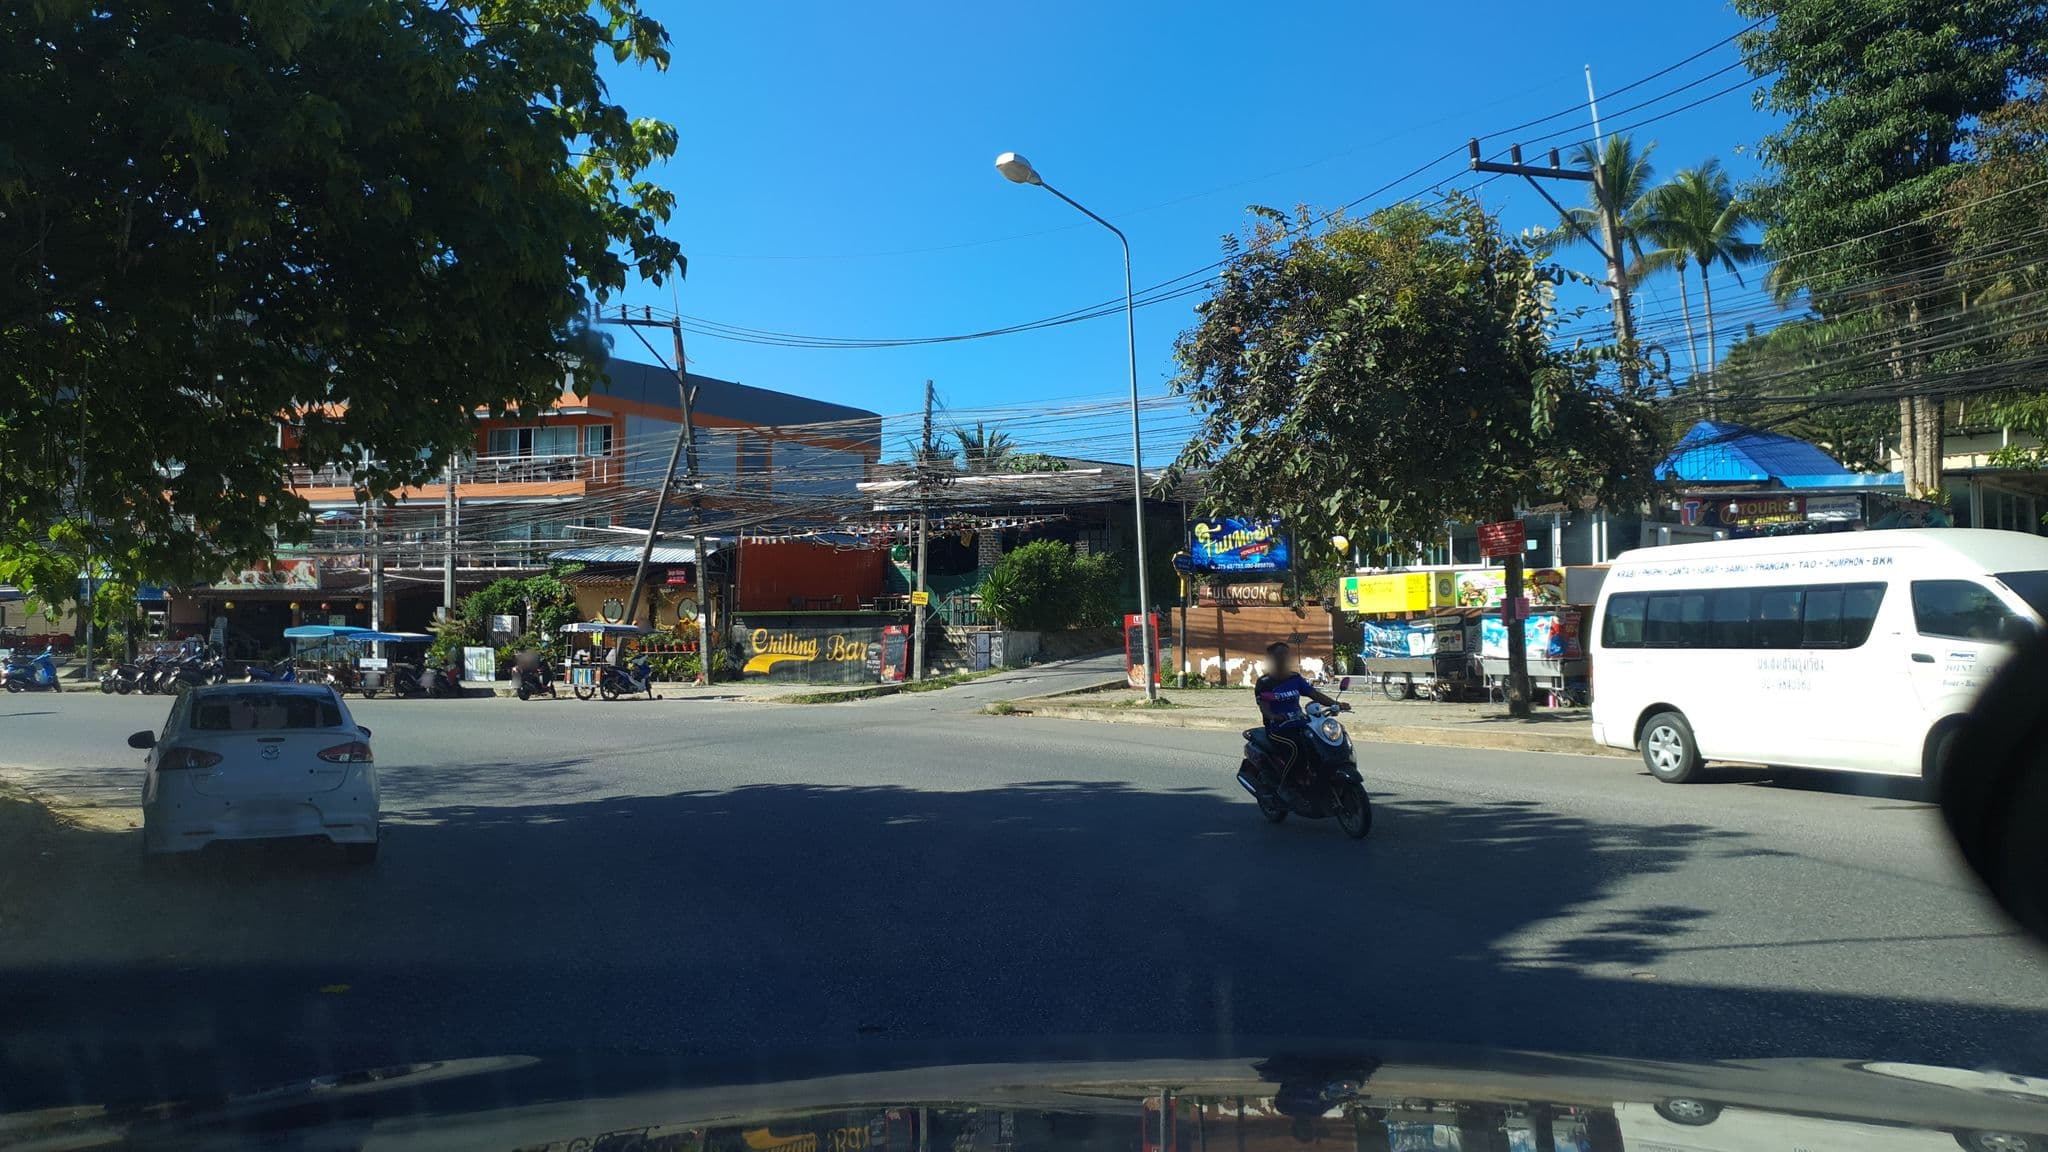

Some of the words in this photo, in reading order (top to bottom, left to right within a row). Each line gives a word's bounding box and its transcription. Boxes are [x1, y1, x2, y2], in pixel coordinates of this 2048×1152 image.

[1799, 559, 1817, 569] TAO
[1872, 555, 1894, 565] BKK
[749, 627, 821, 662] Chilling
[826, 632, 868, 662] Bar
